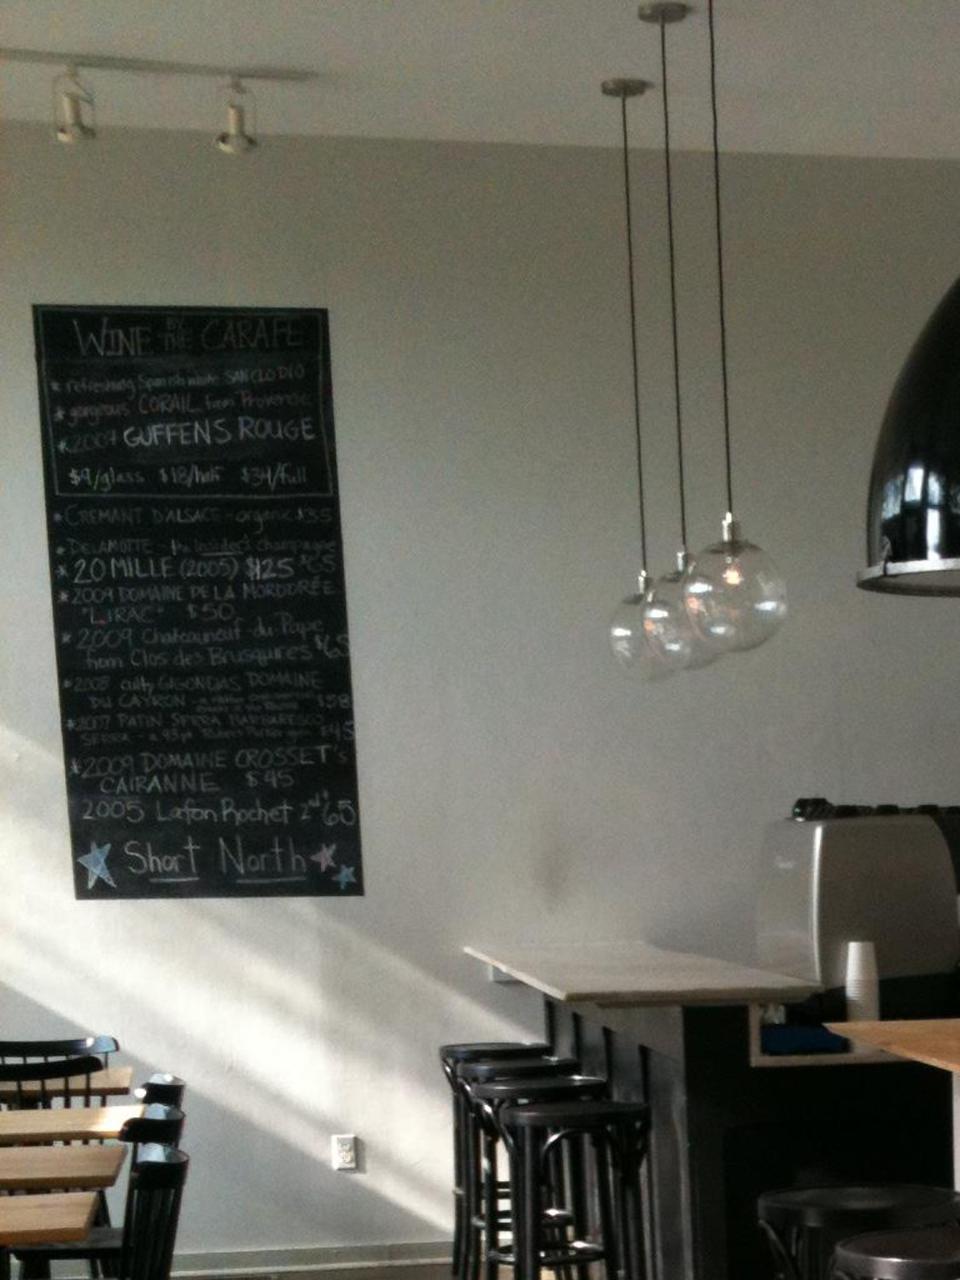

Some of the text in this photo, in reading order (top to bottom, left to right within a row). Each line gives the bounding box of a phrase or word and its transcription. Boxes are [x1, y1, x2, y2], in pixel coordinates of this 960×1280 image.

[72, 316, 153, 356] WINE
[201, 317, 304, 349] CARAFE
[123, 418, 233, 447] GUFFENS
[237, 416, 316, 441] ROUGE
[73, 556, 106, 583] 20
[111, 555, 174, 579] MILLE
[180, 557, 239, 580] (2005)
[119, 584, 184, 602] DOMAINE
[214, 585, 235, 600] LA
[76, 627, 132, 650] 2009
[252, 616, 274, 638] du
[130, 648, 168, 667] Clos
[80, 755, 135, 779] 2009
[140, 750, 228, 774] DOMAINE
[99, 771, 222, 795] CAIRANNE
[82, 799, 145, 823] 2005
[157, 797, 218, 825] Lafon
[221, 797, 294, 826] Rochet
[124, 835, 308, 876] Short North
